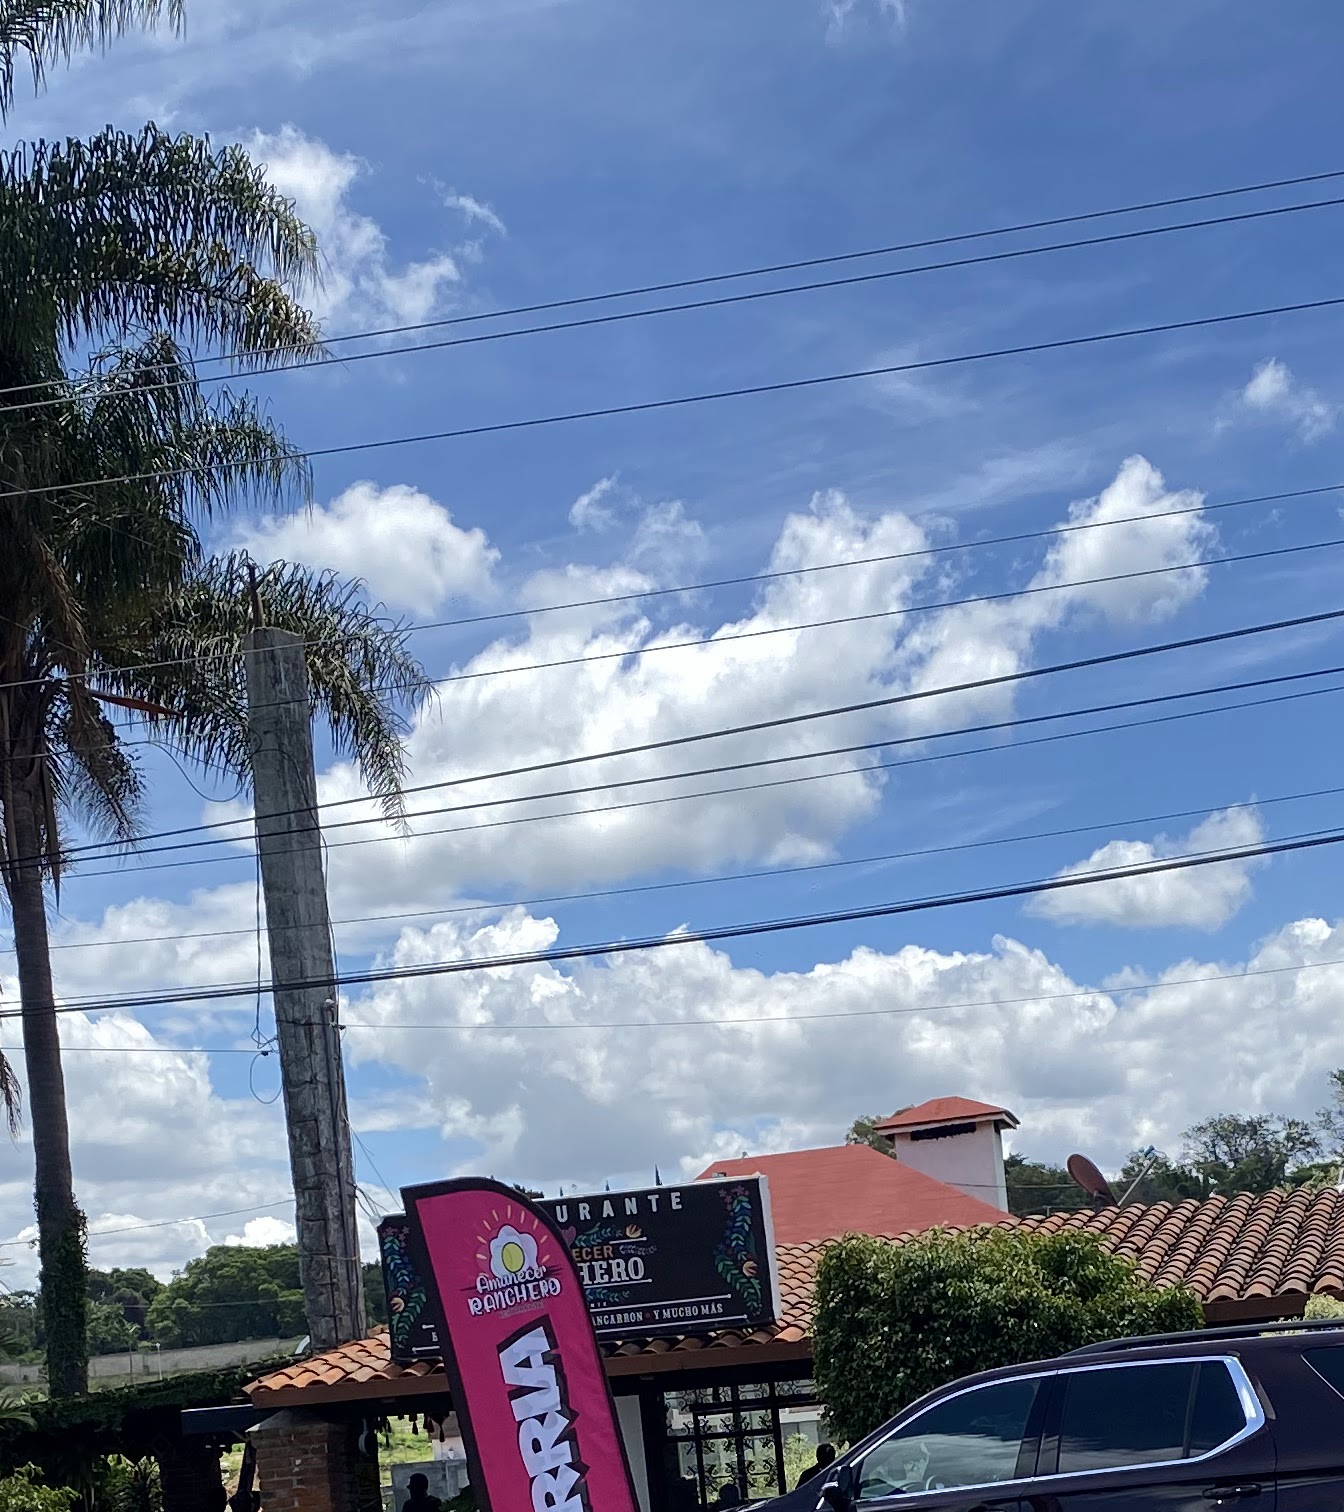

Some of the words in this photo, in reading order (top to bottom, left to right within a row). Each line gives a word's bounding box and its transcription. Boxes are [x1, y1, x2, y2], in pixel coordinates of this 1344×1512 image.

[476, 1265, 547, 1294] Amanecer
[467, 1277, 561, 1316] RANCHERO
[653, 1309, 660, 1321] Y
[662, 1306, 698, 1319] MUCHO
[701, 1302, 723, 1315] MÁS
